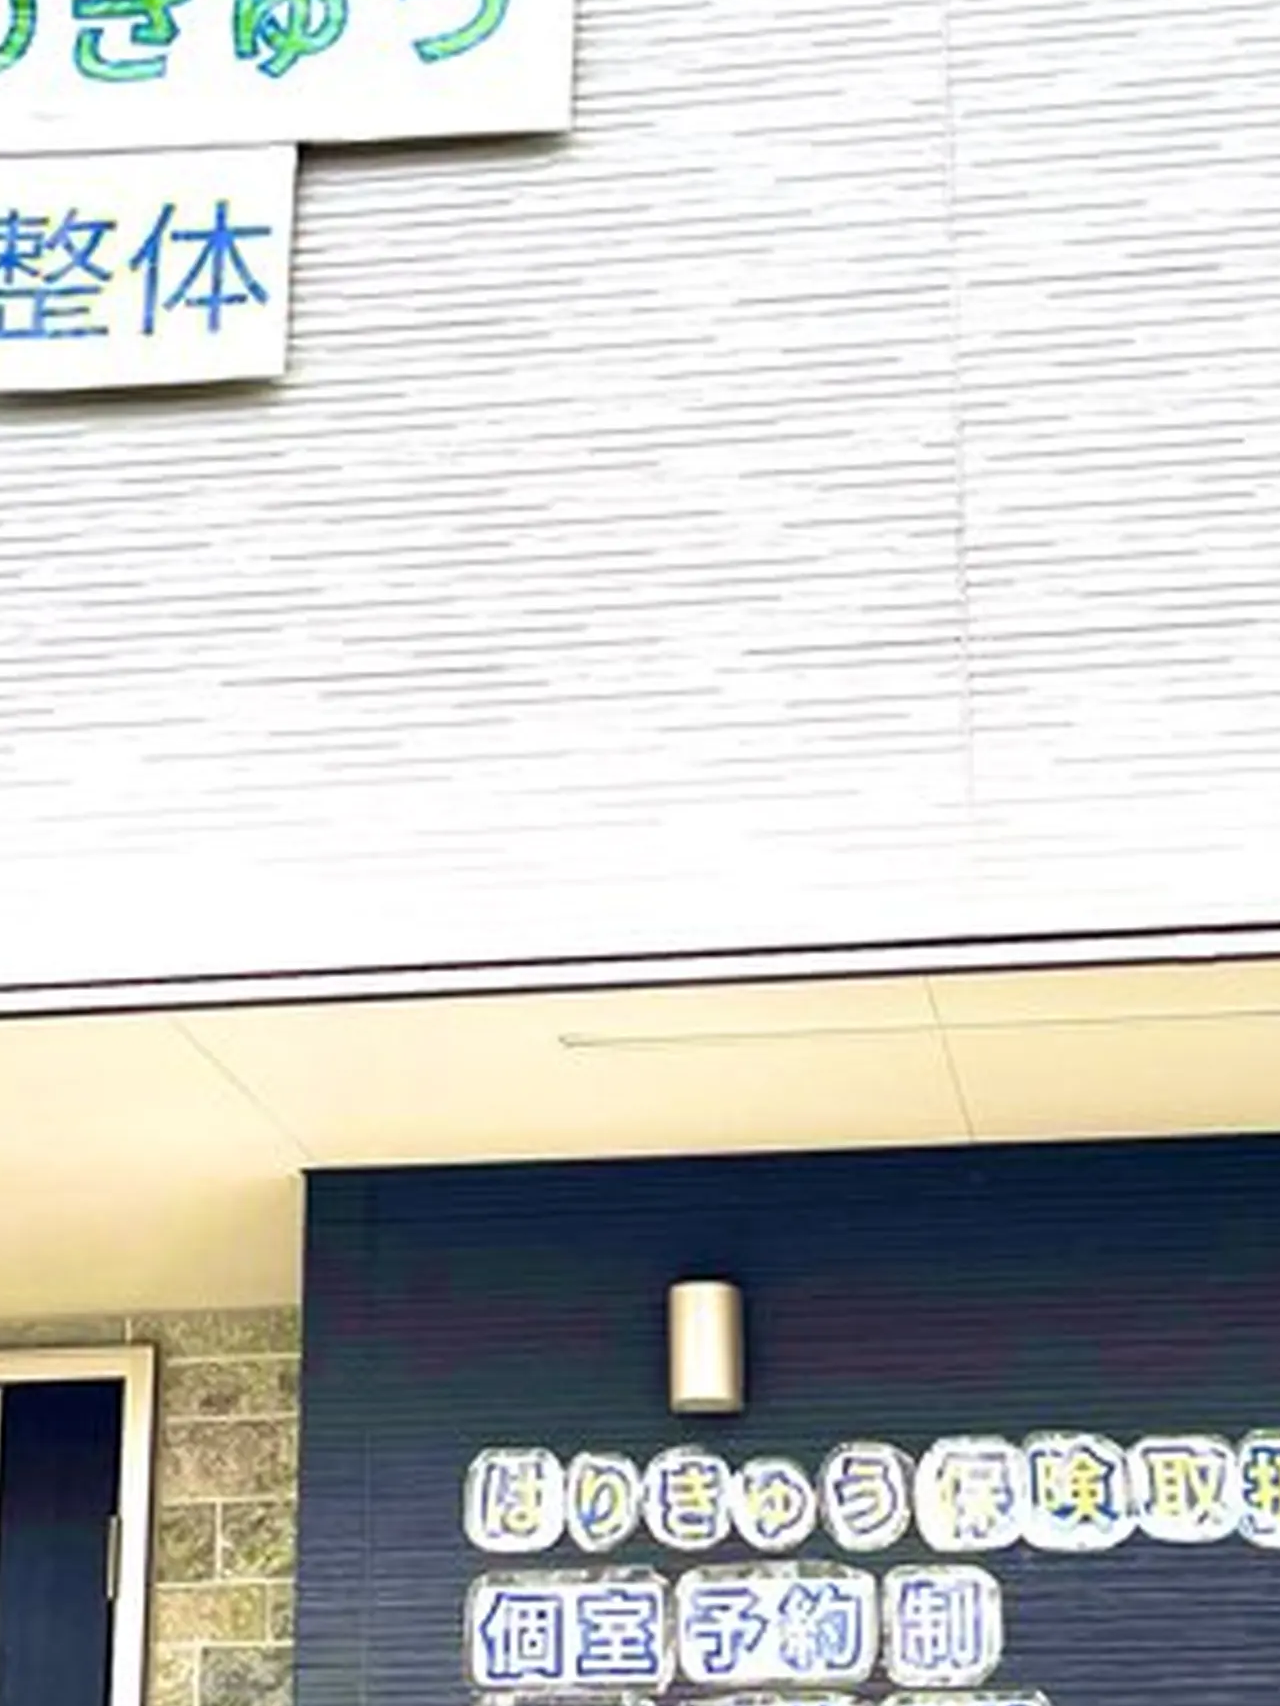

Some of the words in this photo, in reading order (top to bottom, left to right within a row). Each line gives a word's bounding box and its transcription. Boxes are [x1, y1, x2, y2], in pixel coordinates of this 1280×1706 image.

[479, 1583, 982, 1679] 個室予約制
